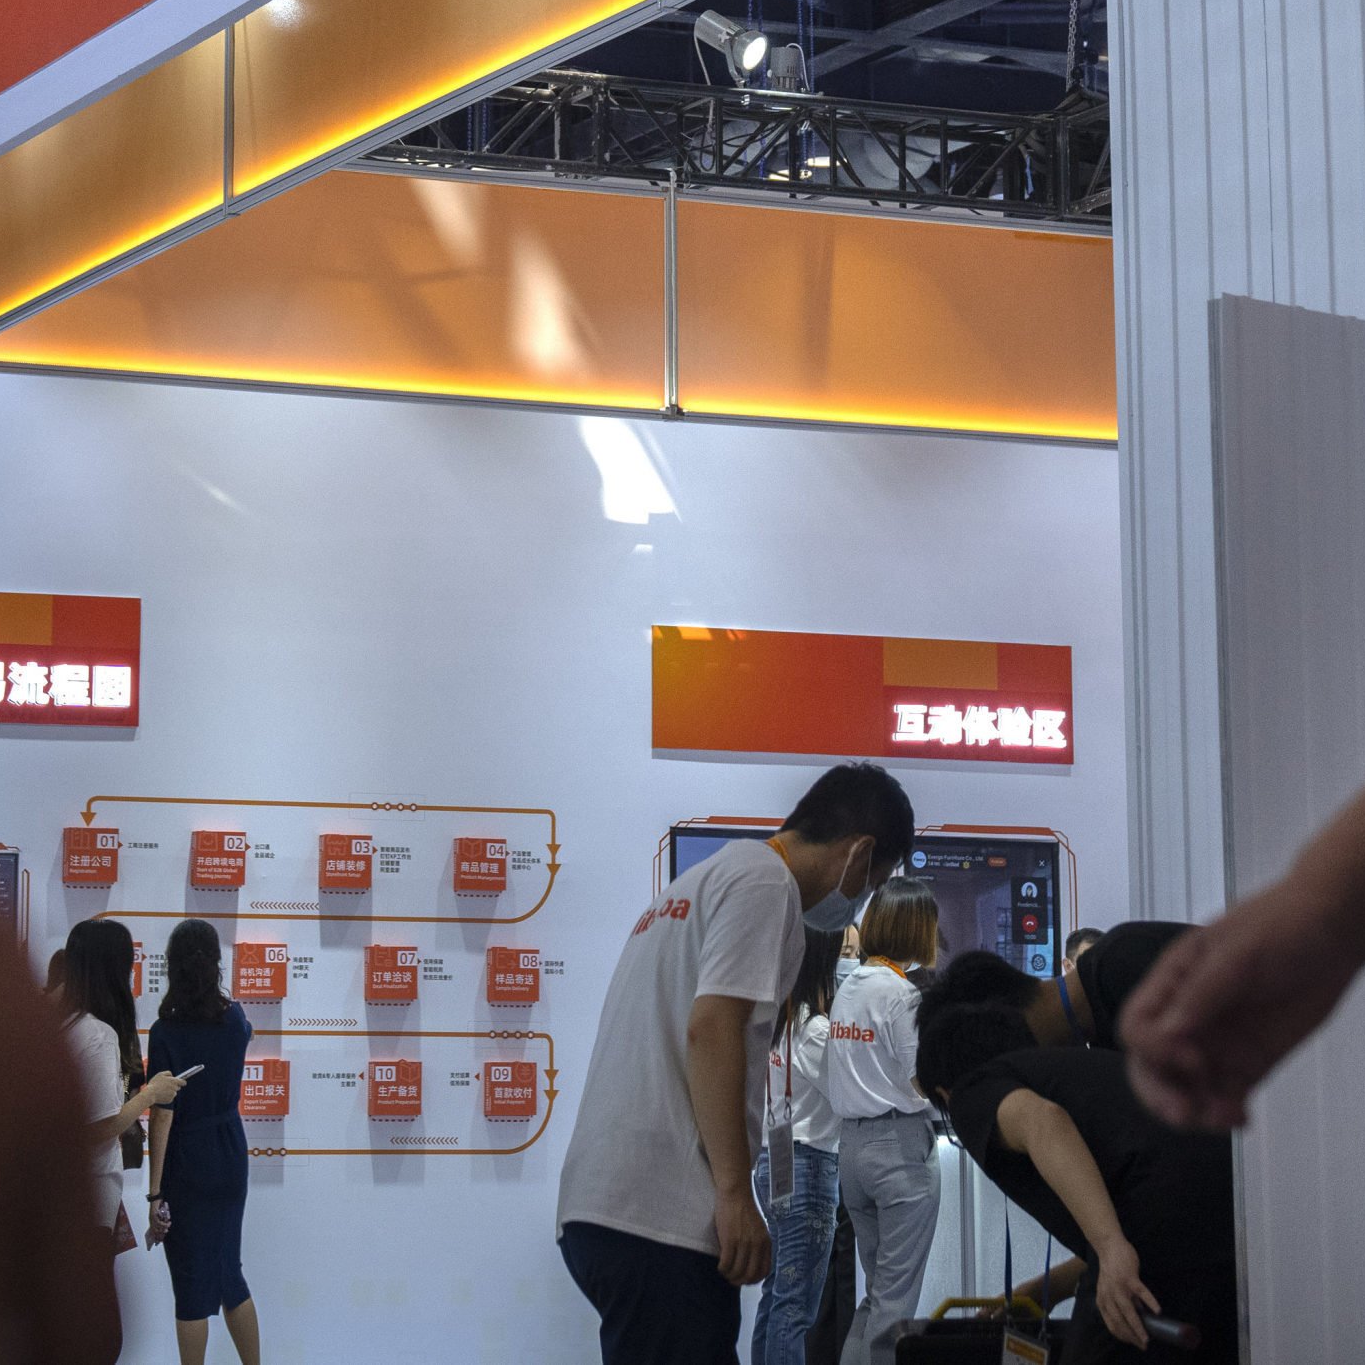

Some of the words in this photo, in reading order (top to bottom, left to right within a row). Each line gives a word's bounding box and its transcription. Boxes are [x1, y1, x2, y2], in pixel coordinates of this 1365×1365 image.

[892, 704, 1067, 748] 互动体验区
[100, 835, 115, 847] 01
[227, 837, 243, 850] 02
[354, 841, 370, 853] 03
[489, 844, 504, 857] 04
[69, 855, 112, 867] 注册公司
[197, 856, 244, 867] 开启跨境电商
[326, 860, 366, 872] 店铺装修
[460, 861, 499, 874] 商品管理
[268, 949, 284, 961] 06
[400, 952, 416, 965] 07
[522, 955, 538, 967] 08
[239, 967, 275, 977] 商机沟通/
[372, 971, 412, 983] 订单洽谈
[239, 978, 271, 987] 客户管理
[495, 973, 534, 985] 样品寄送
[828, 1021, 875, 1043] libaba
[245, 1067, 259, 1079] 11
[378, 1068, 393, 1080] 10
[493, 1068, 509, 1080] 09
[245, 1084, 285, 1096] 出口报关
[378, 1085, 418, 1097] 生产备货
[494, 1087, 533, 1099] 首款收付
